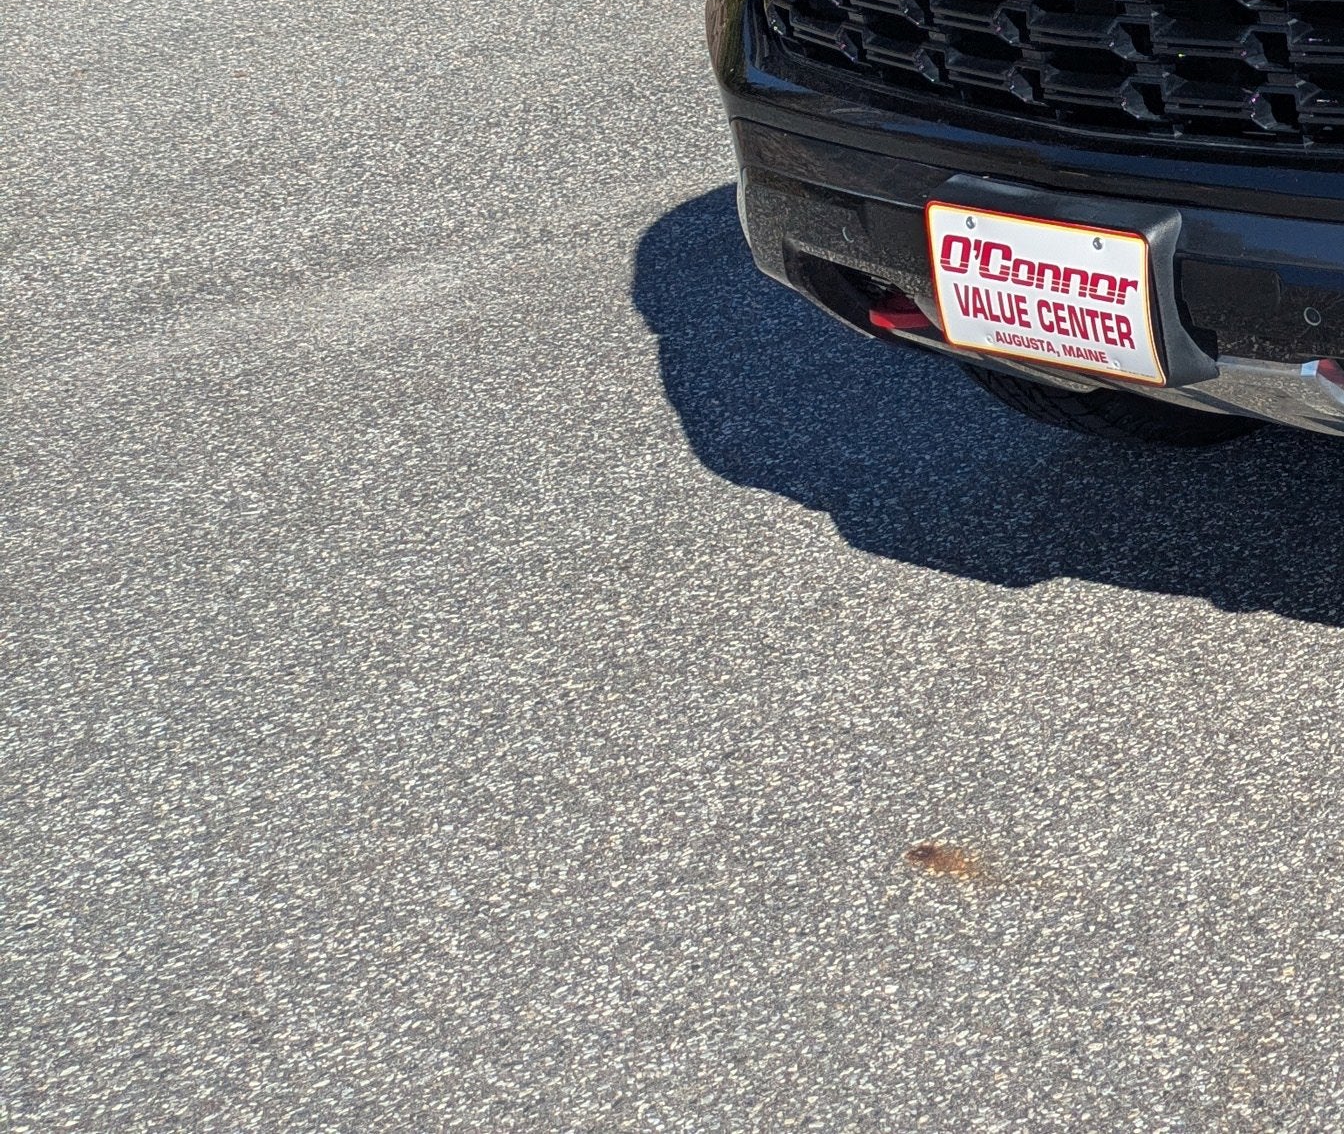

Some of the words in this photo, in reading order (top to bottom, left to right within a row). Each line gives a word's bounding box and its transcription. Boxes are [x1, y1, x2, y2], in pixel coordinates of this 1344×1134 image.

[939, 234, 1138, 305] O'Connor
[953, 282, 1031, 329] VALUE
[1036, 299, 1135, 350] CENTER
[995, 330, 1060, 358] AUGUSTA,
[1062, 344, 1109, 364] MAINE
